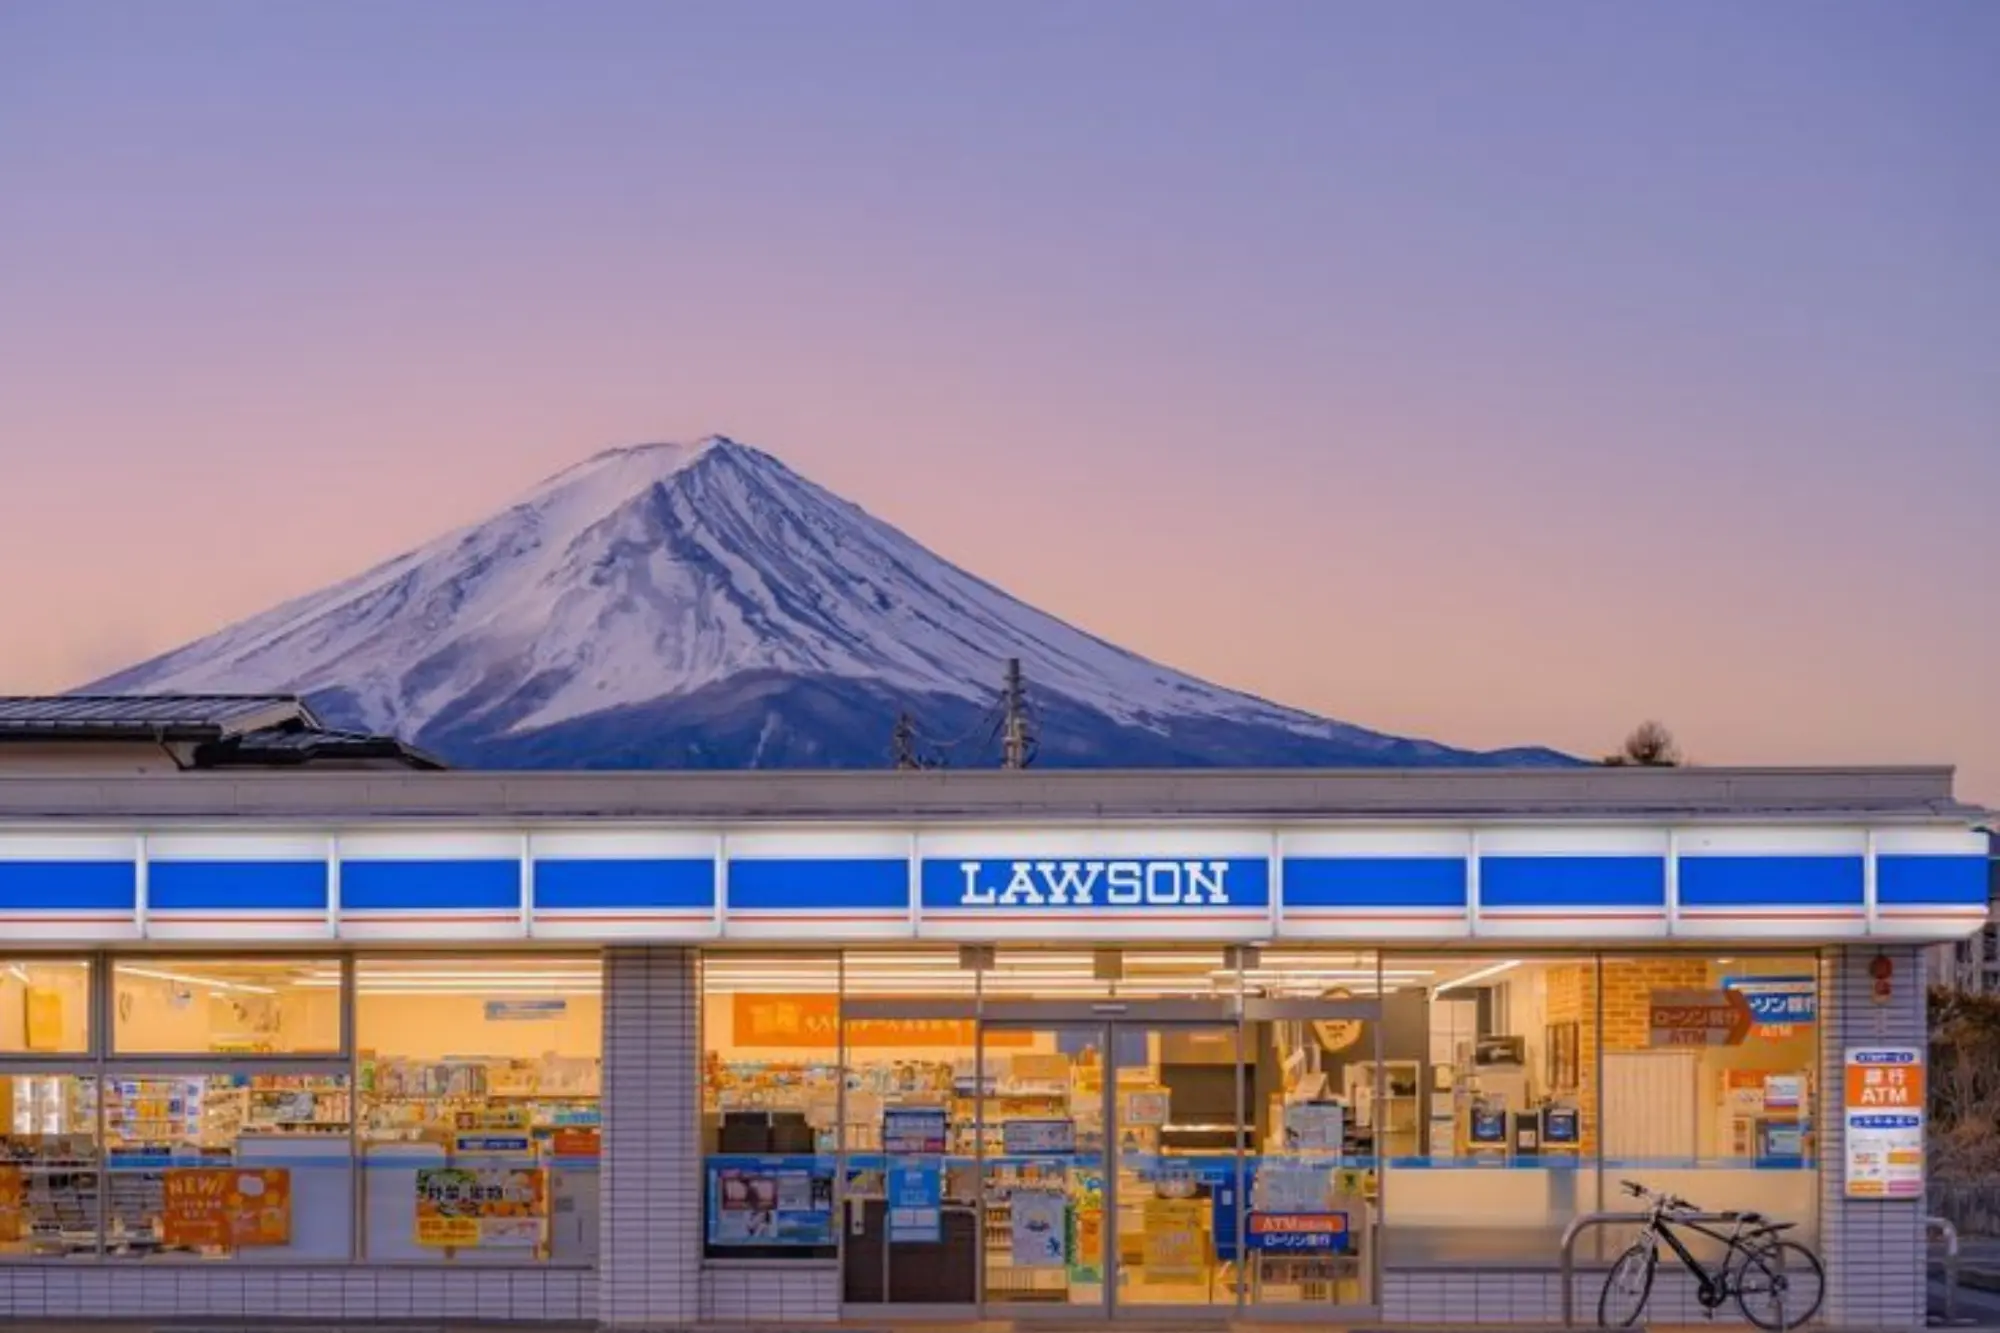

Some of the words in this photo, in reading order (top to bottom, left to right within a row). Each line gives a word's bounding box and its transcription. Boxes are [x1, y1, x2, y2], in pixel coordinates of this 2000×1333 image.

[960, 861, 1230, 905] LAWSON
[1669, 1029, 1707, 1045] ATM
[1760, 1024, 1793, 1036] ATM
[1861, 1087, 1908, 1105] ATM
[1263, 1216, 1298, 1231] ATM
